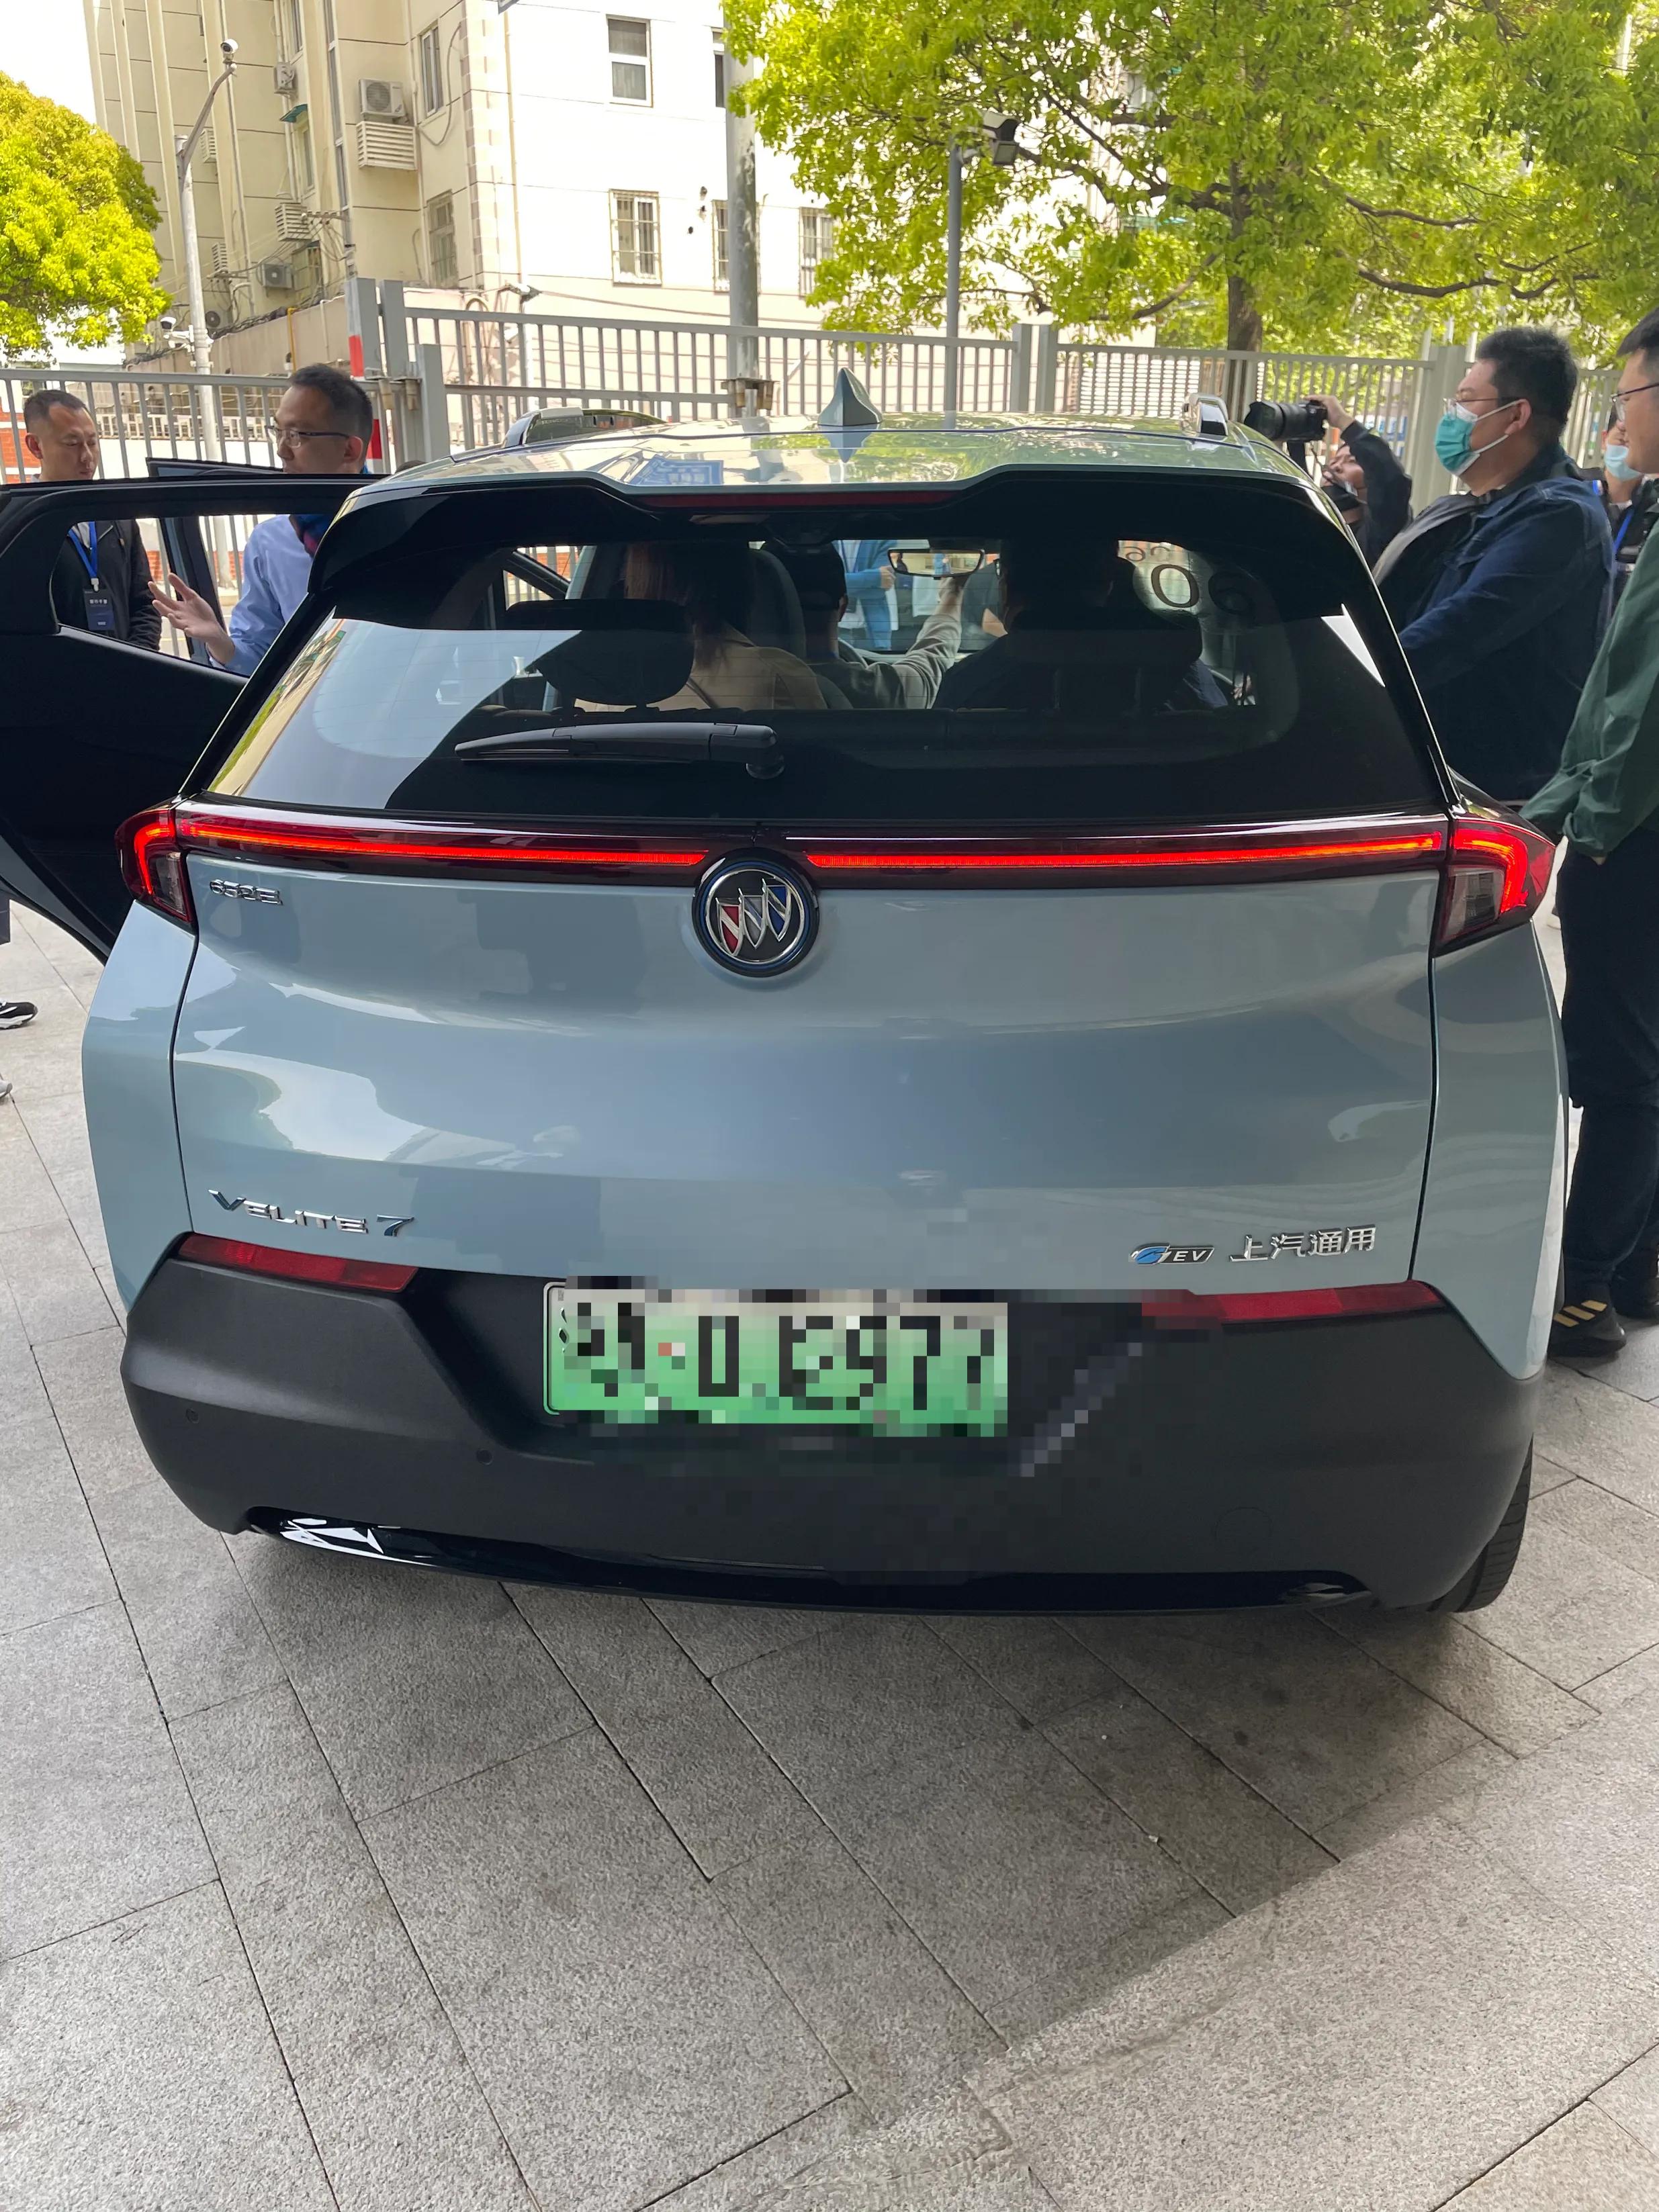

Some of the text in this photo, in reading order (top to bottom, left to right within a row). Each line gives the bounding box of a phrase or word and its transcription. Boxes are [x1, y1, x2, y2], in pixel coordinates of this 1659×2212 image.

[208, 1189, 414, 1236] VELITE 7
[1230, 1224, 1376, 1262] 上汽通用
